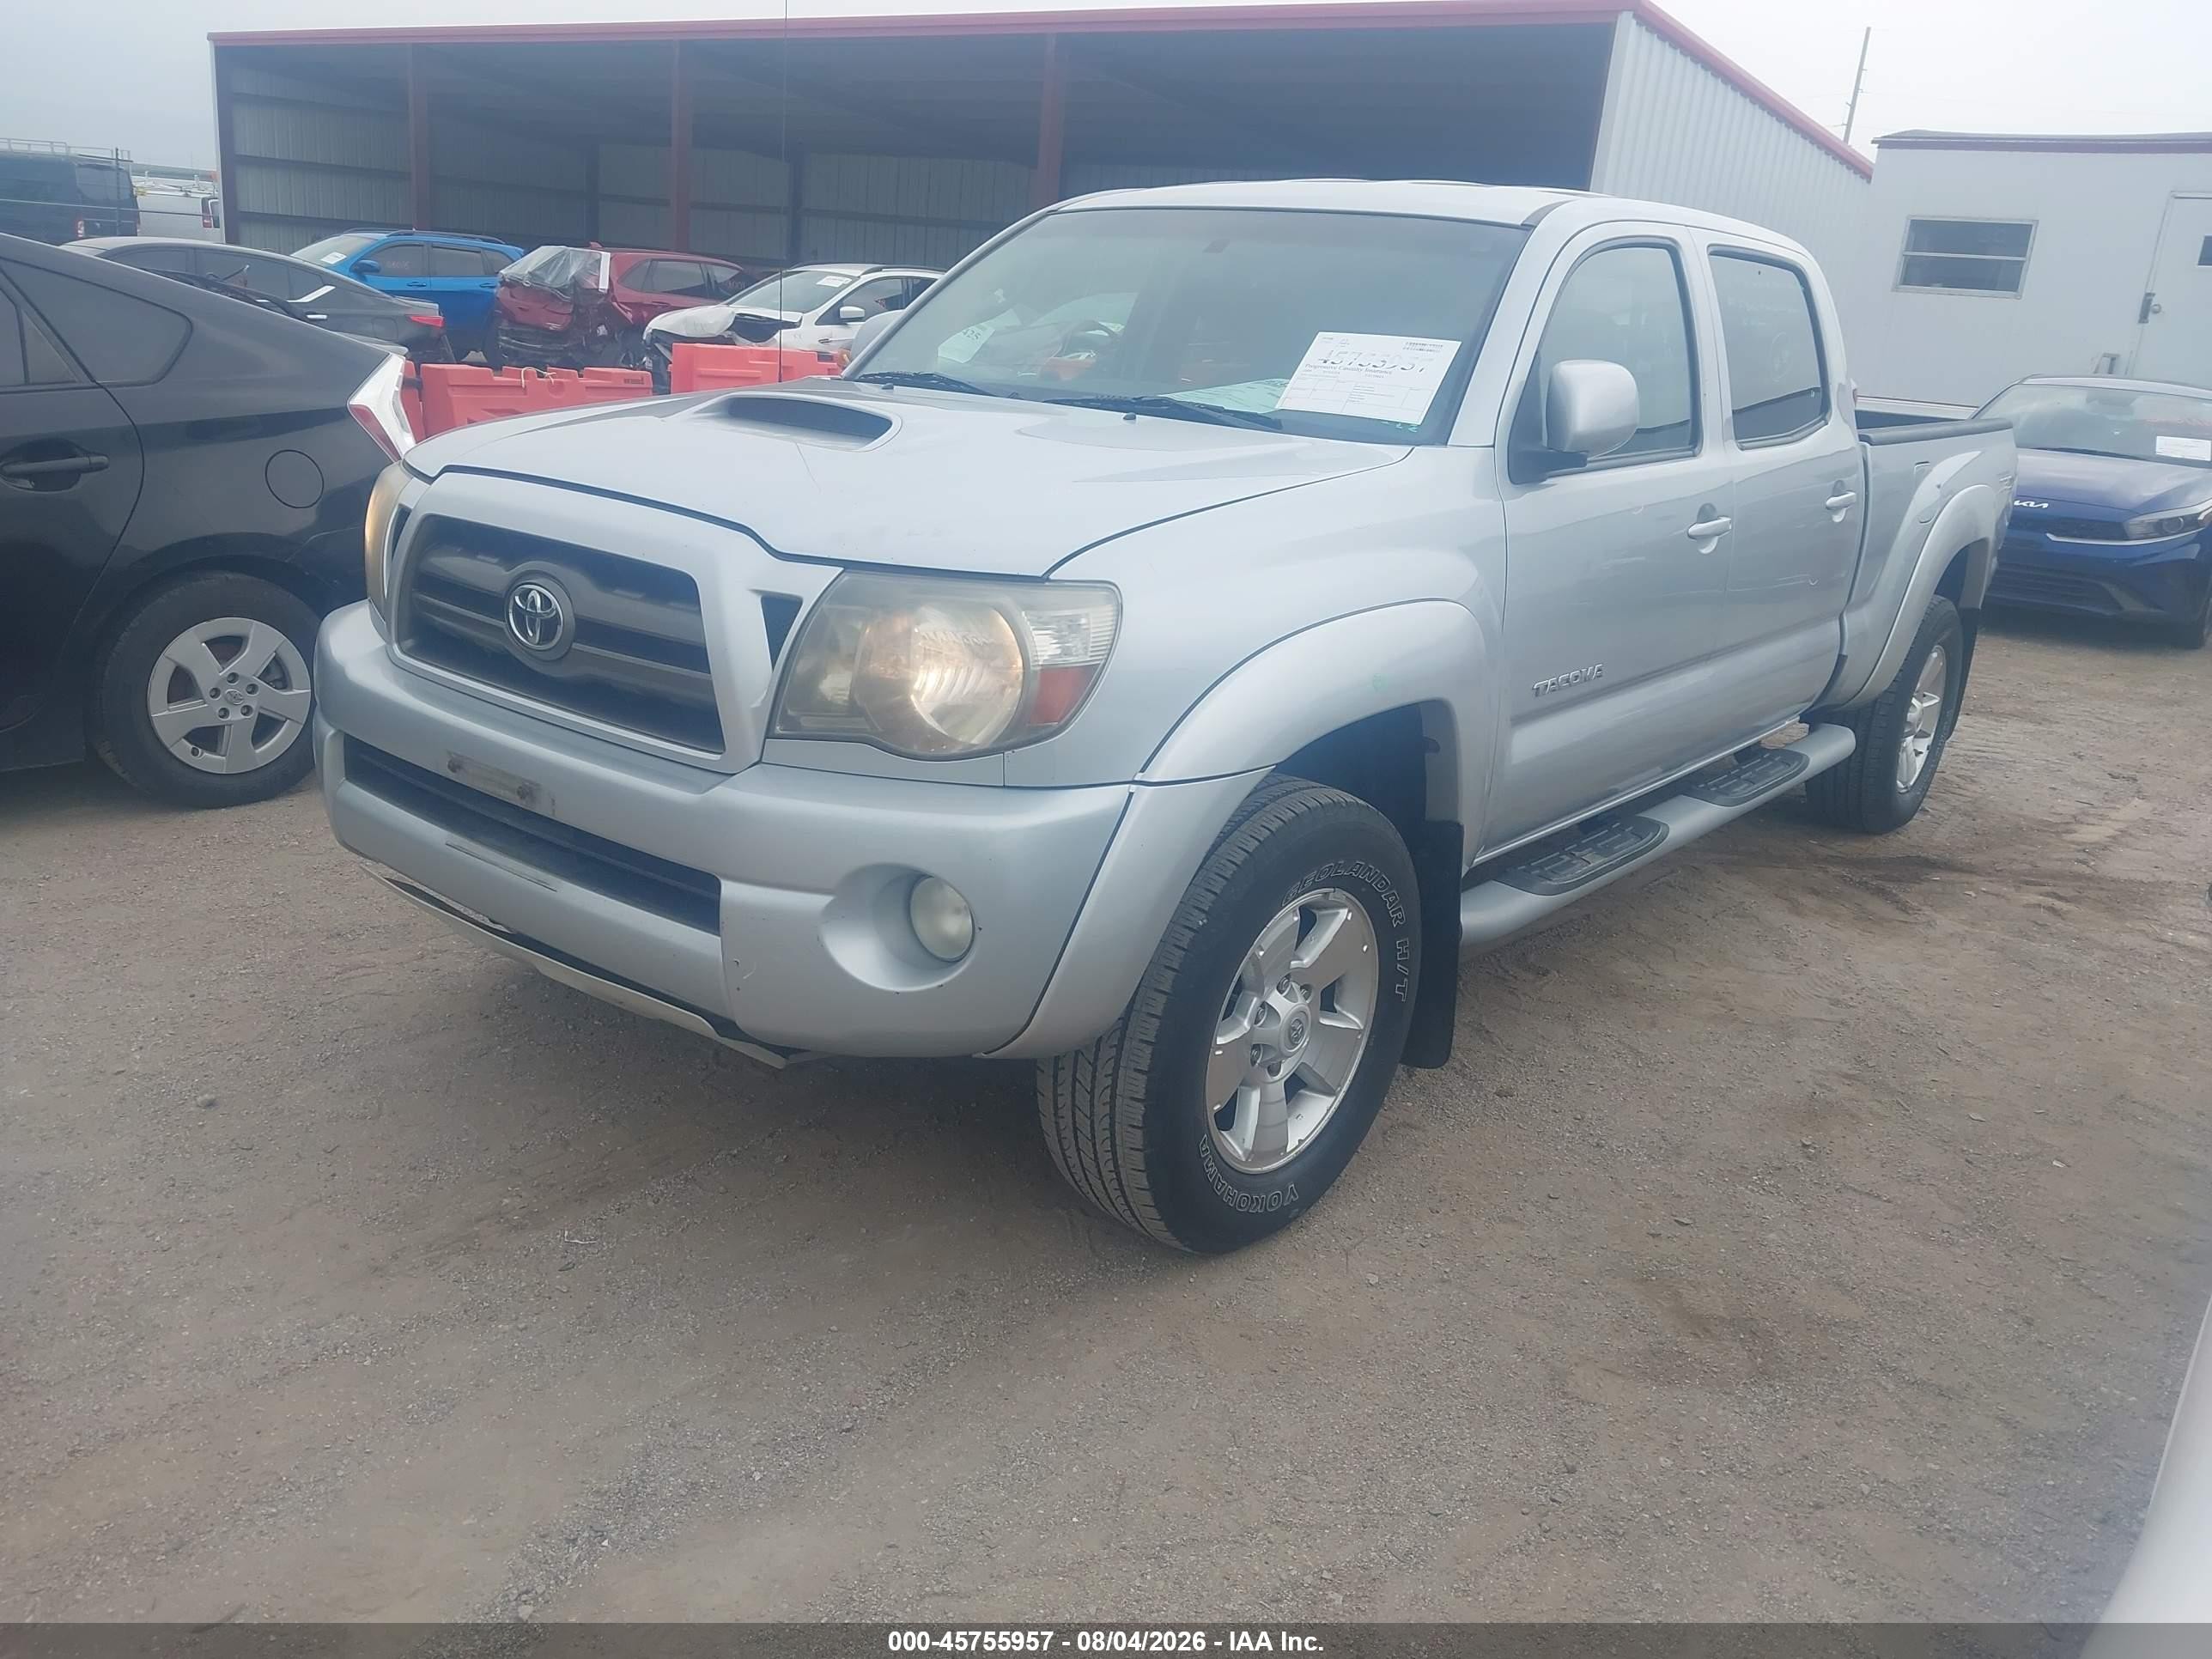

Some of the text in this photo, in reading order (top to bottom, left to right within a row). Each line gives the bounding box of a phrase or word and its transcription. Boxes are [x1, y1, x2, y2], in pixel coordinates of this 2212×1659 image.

[1532, 664, 1603, 697] TACOMA
[1282, 861, 1410, 1001] GEOLANDAR H/T
[1200, 1133, 1299, 1213] YOKOHAMA
